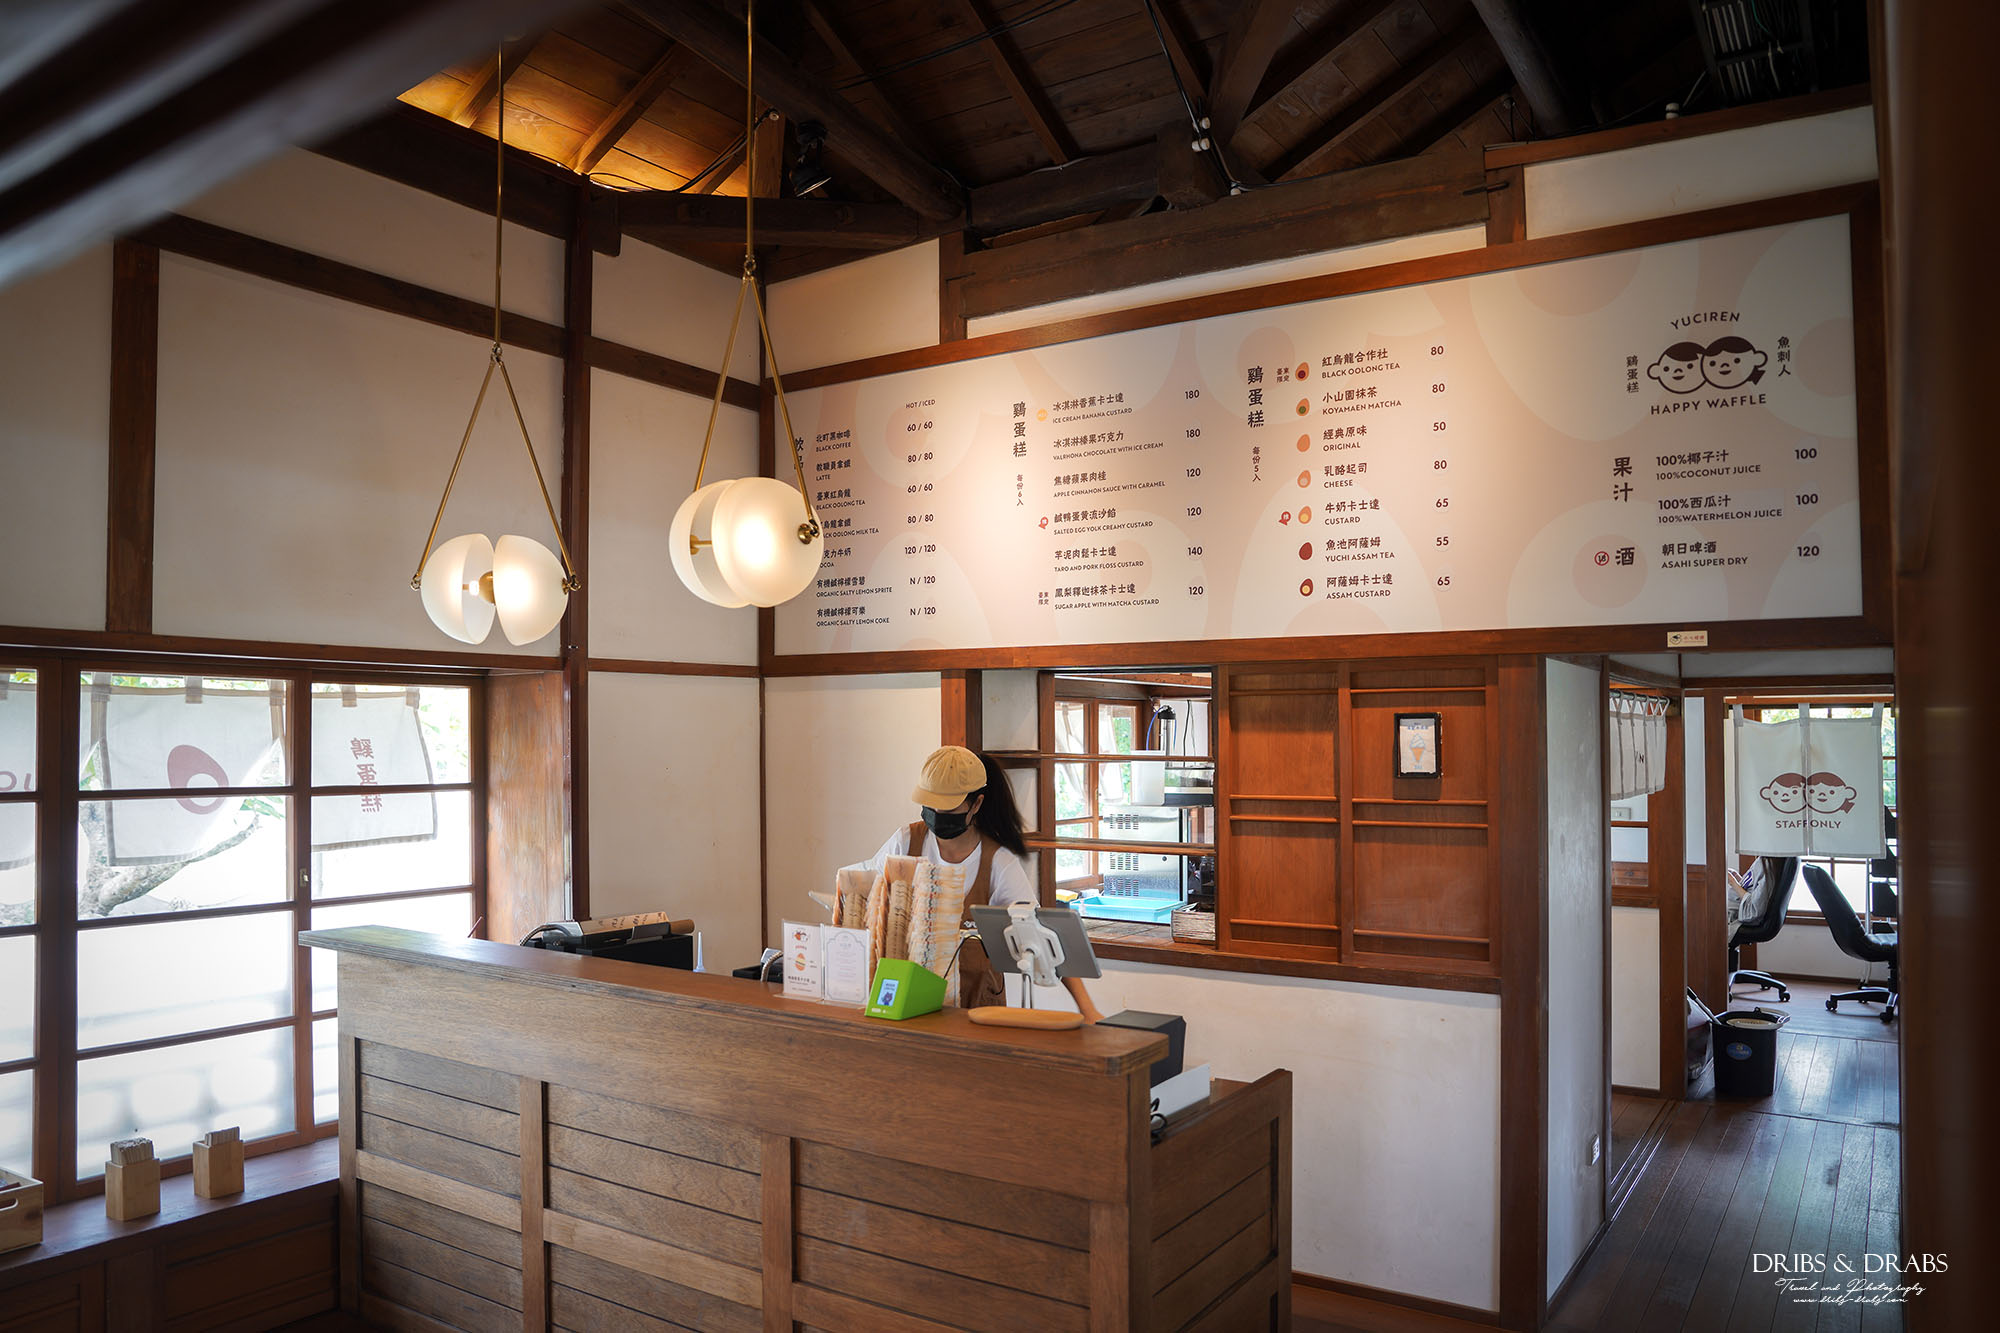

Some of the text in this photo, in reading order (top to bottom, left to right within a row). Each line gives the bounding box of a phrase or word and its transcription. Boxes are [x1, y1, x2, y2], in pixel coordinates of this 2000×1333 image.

[1670, 311, 1741, 330] YUCIREN
[1431, 346, 1444, 355] 80
[1322, 349, 1388, 366] 紅烏龍合作社
[1777, 336, 1791, 377] 魚刺人
[1322, 362, 1400, 378] BLACK OOLONG TEA
[1432, 383, 1445, 393] 80
[1185, 390, 1200, 399] 180
[1323, 387, 1377, 403] 小山園抹茶
[1053, 392, 1124, 412] 冰淇淋香蕉卡士達
[1322, 400, 1401, 415] KOYAMAEN MATCHA
[1650, 393, 1767, 415] HAPPY WAFFLE
[1106, 408, 1132, 416] CUSTARD
[907, 424, 916, 432] 60
[924, 421, 933, 429] 60
[1433, 422, 1446, 431] 50
[1186, 429, 1200, 438] 180
[1323, 425, 1367, 440] 經典原味
[832, 442, 851, 450] COFFEE
[1053, 452, 1083, 460] VALRHONA
[1083, 448, 1116, 457] CHOCOLATE
[1143, 442, 1163, 450] CREAM
[1323, 442, 1360, 451] ORIGINAL
[908, 454, 916, 463] 80
[924, 452, 933, 460] 80
[1656, 450, 1729, 466] 100%椰子汁
[1795, 448, 1817, 459] 100
[1324, 462, 1367, 477] 乳酪起司
[1434, 460, 1447, 469] 80
[1186, 468, 1201, 477] 120
[1656, 465, 1760, 480] 100%COCONUT JUICE
[1054, 471, 1106, 486] 焦糖蘋果肉桂
[1324, 479, 1353, 488] CHEESE
[1613, 456, 1634, 503] 果汁
[907, 485, 916, 493] 60
[924, 483, 933, 491] 60
[1071, 488, 1101, 496] CINNAMON
[1137, 481, 1165, 489] CARAMEL
[832, 500, 855, 508] OOLONG
[1436, 498, 1448, 508] 65
[1658, 495, 1731, 510] 100%西瓜汁
[1796, 494, 1818, 505] 100
[1187, 507, 1201, 516] 120
[1325, 499, 1380, 513] 牛奶卡士達
[907, 515, 916, 524] 80
[925, 514, 933, 522] 80
[1325, 516, 1360, 525] CUSTARD
[1658, 509, 1782, 523] 100%WATERMELON JUICE
[821, 518, 851, 530] 烏龍拿鐵
[1326, 536, 1381, 550] 魚池阿薩姆
[1436, 536, 1449, 546] 55
[823, 547, 851, 559] 克力牛奶
[905, 546, 916, 554] 120
[924, 544, 936, 552] 120
[1188, 547, 1203, 555] 140
[1662, 541, 1716, 556] 朝日啤酒
[1797, 545, 1819, 557] 120
[1615, 547, 1635, 566] 酒
[1661, 557, 1748, 568] ASAHI SUPER DRY
[924, 576, 935, 584] 120
[1327, 573, 1393, 588] 阿薩姆卡士達
[1437, 576, 1450, 586] 65
[1189, 586, 1203, 595] 120
[1354, 590, 1391, 598] CUSTARD
[924, 607, 936, 615] 120
[1775, 819, 1842, 829] STAFF ONLY
